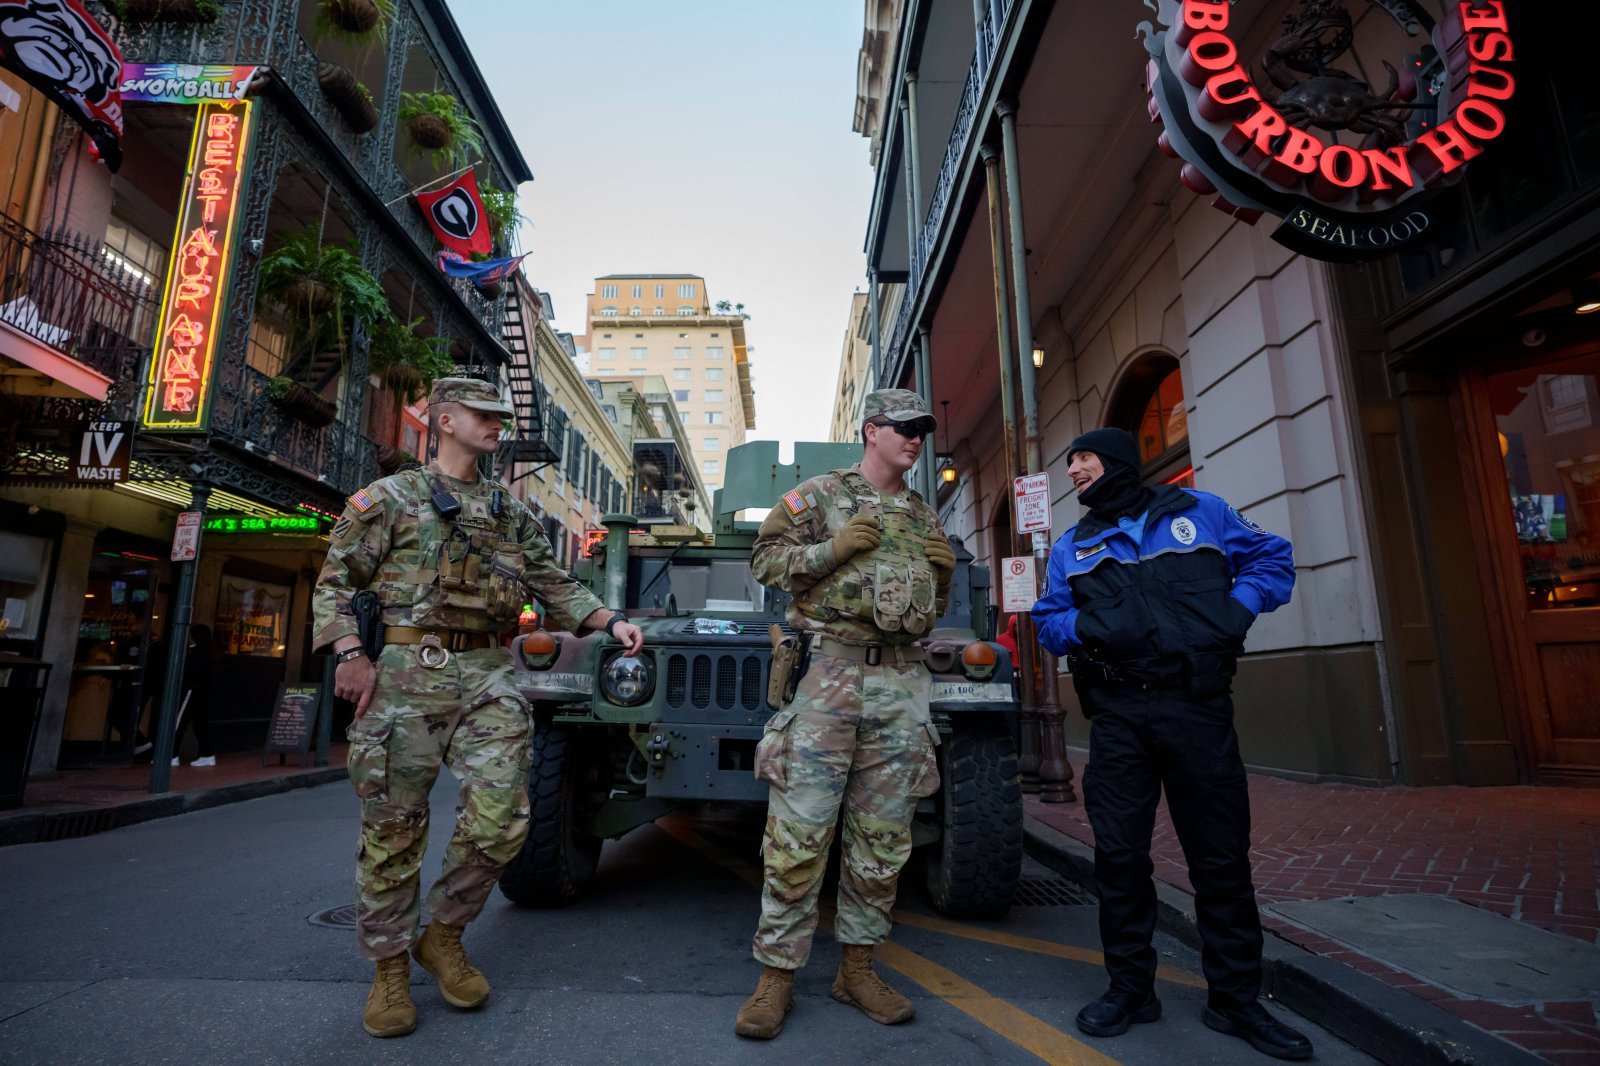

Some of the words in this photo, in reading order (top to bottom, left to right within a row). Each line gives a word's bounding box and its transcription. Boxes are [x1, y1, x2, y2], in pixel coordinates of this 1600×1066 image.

[119, 78, 246, 99] SNOWBALLS
[1183, 0, 1414, 190] BOURBON
[1416, 1, 1516, 173] HOUSE
[1292, 209, 1429, 246] SEAFOOD
[163, 113, 234, 406] RESTAURANT
[89, 421, 122, 431] KEEP
[80, 431, 124, 467] IV
[77, 466, 121, 480] WASTE
[1026, 480, 1047, 490] PARKING
[1020, 493, 1044, 504] FREIGHT
[1025, 501, 1040, 511] ZONE
[202, 518, 238, 530] IX'S
[241, 518, 266, 529] SEA
[270, 517, 317, 528] FOODS
[180, 527, 193, 537] FIRE
[177, 537, 192, 547] LANE
